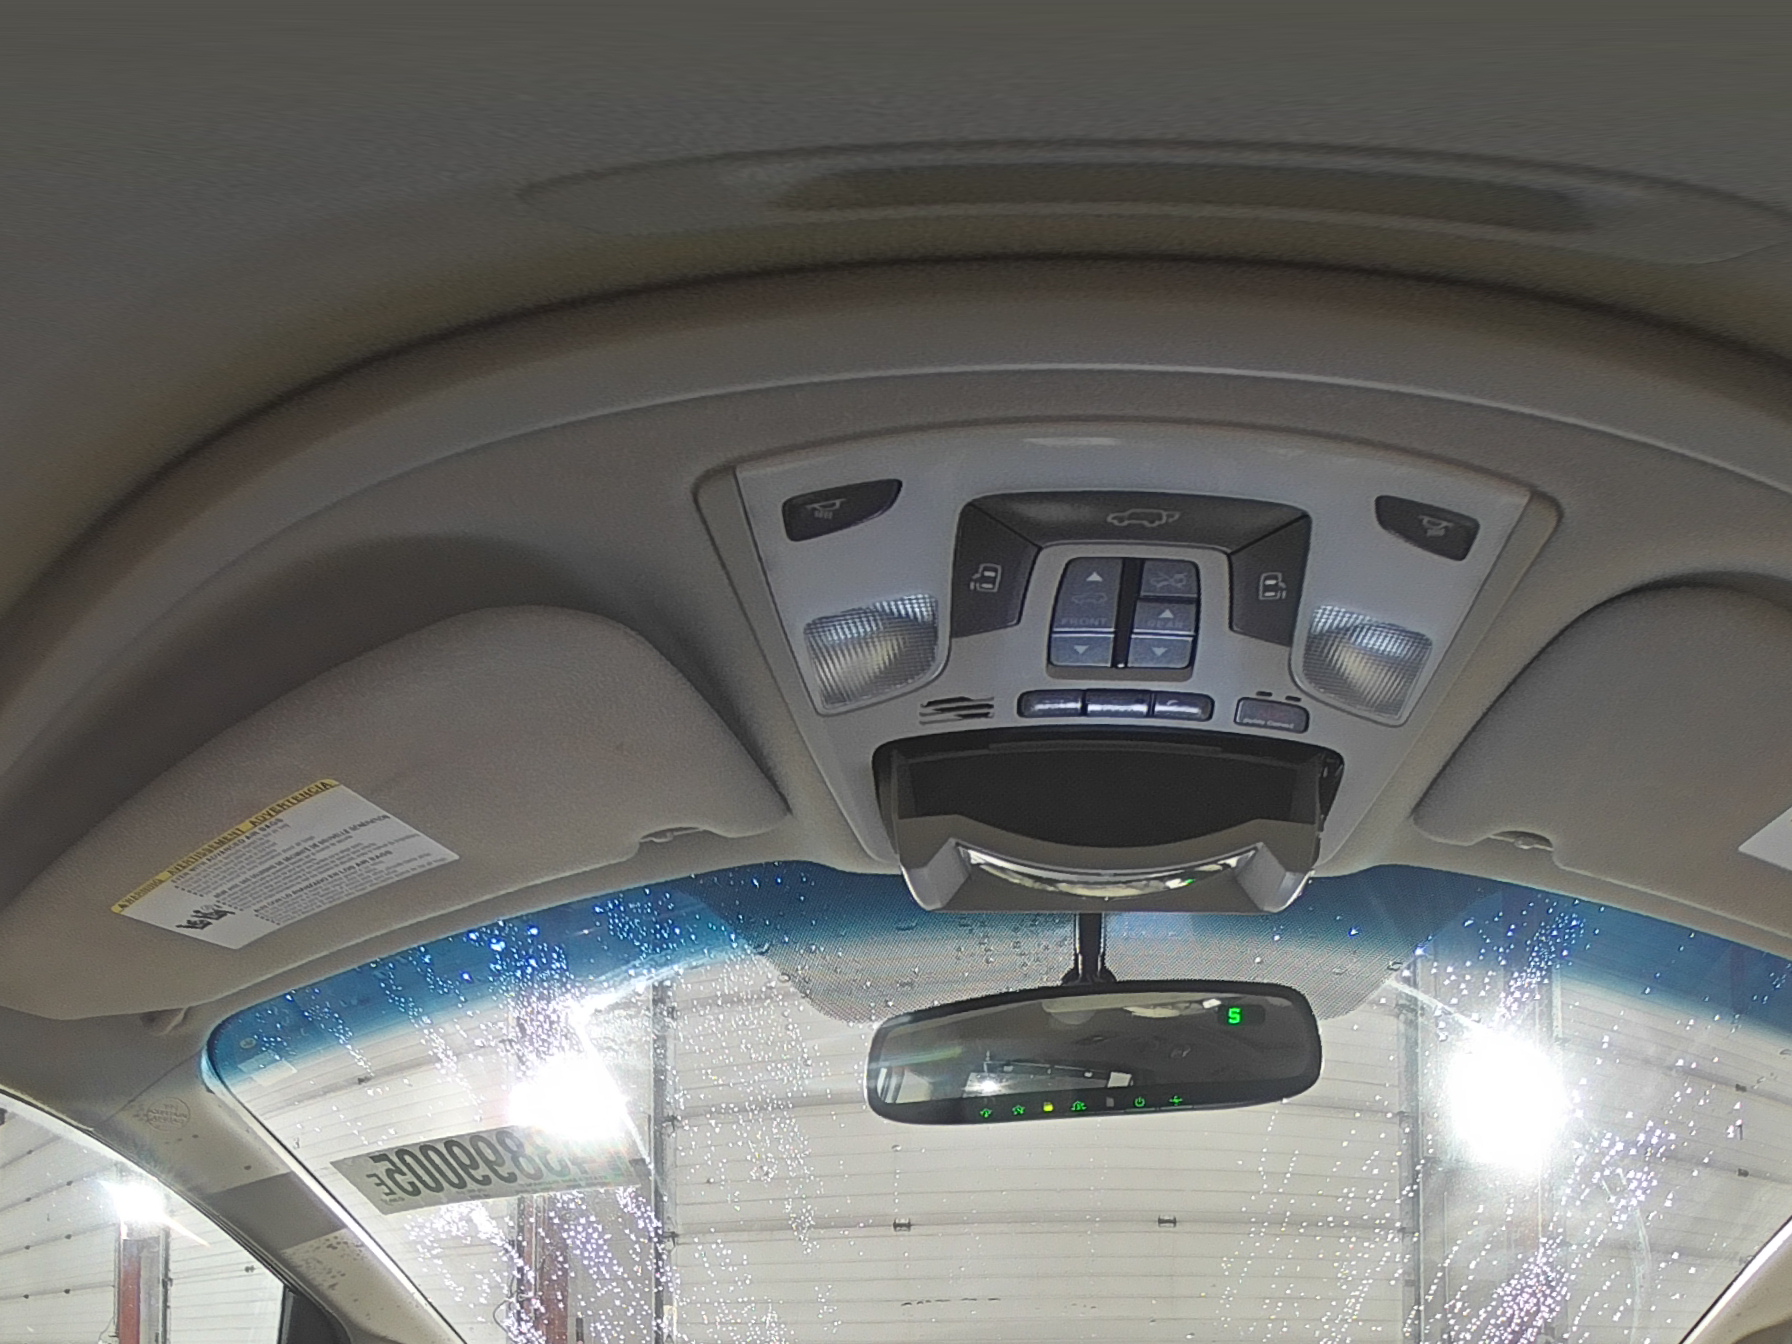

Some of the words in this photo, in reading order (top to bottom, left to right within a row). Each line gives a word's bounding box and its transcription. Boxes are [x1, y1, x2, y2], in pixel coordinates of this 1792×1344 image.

[1060, 616, 1107, 626] FRONT
[168, 827, 246, 877] AVERTISSEMENT
[248, 781, 332, 827] ADVERTENCIA
